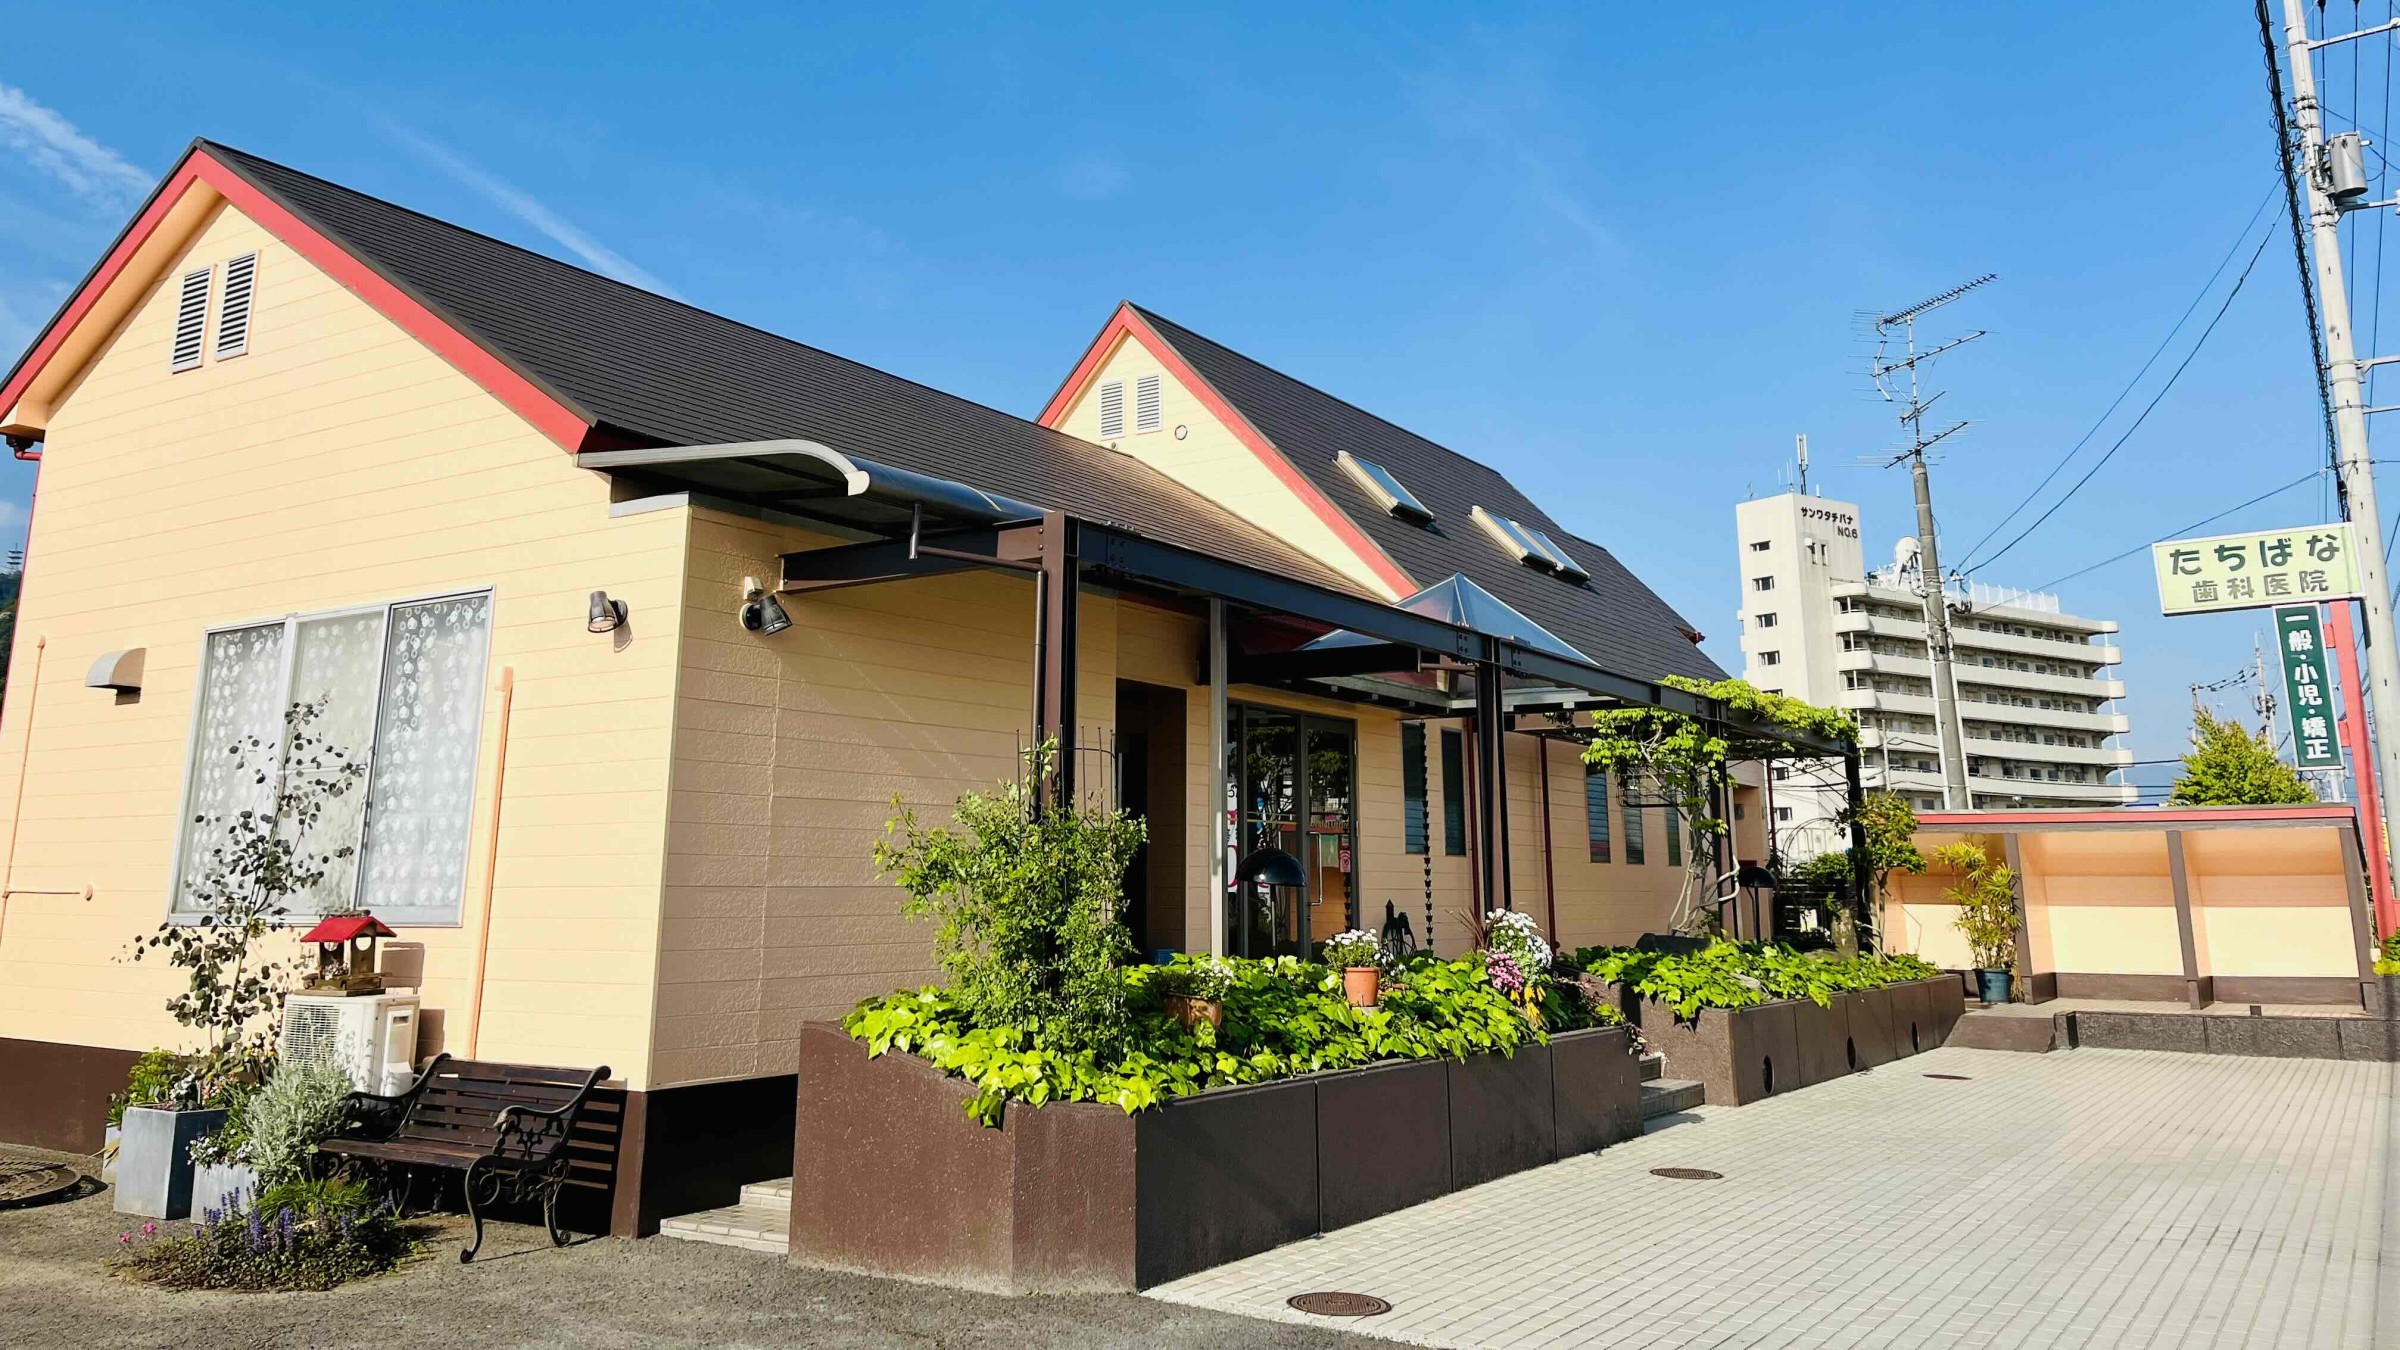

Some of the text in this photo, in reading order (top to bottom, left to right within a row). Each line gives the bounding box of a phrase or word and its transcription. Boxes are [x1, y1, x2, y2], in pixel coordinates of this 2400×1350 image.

[1801, 507, 1853, 525] サンワタチバナ
[2169, 534, 2340, 576] たちばな
[2192, 569, 2329, 603] 歯科医院
